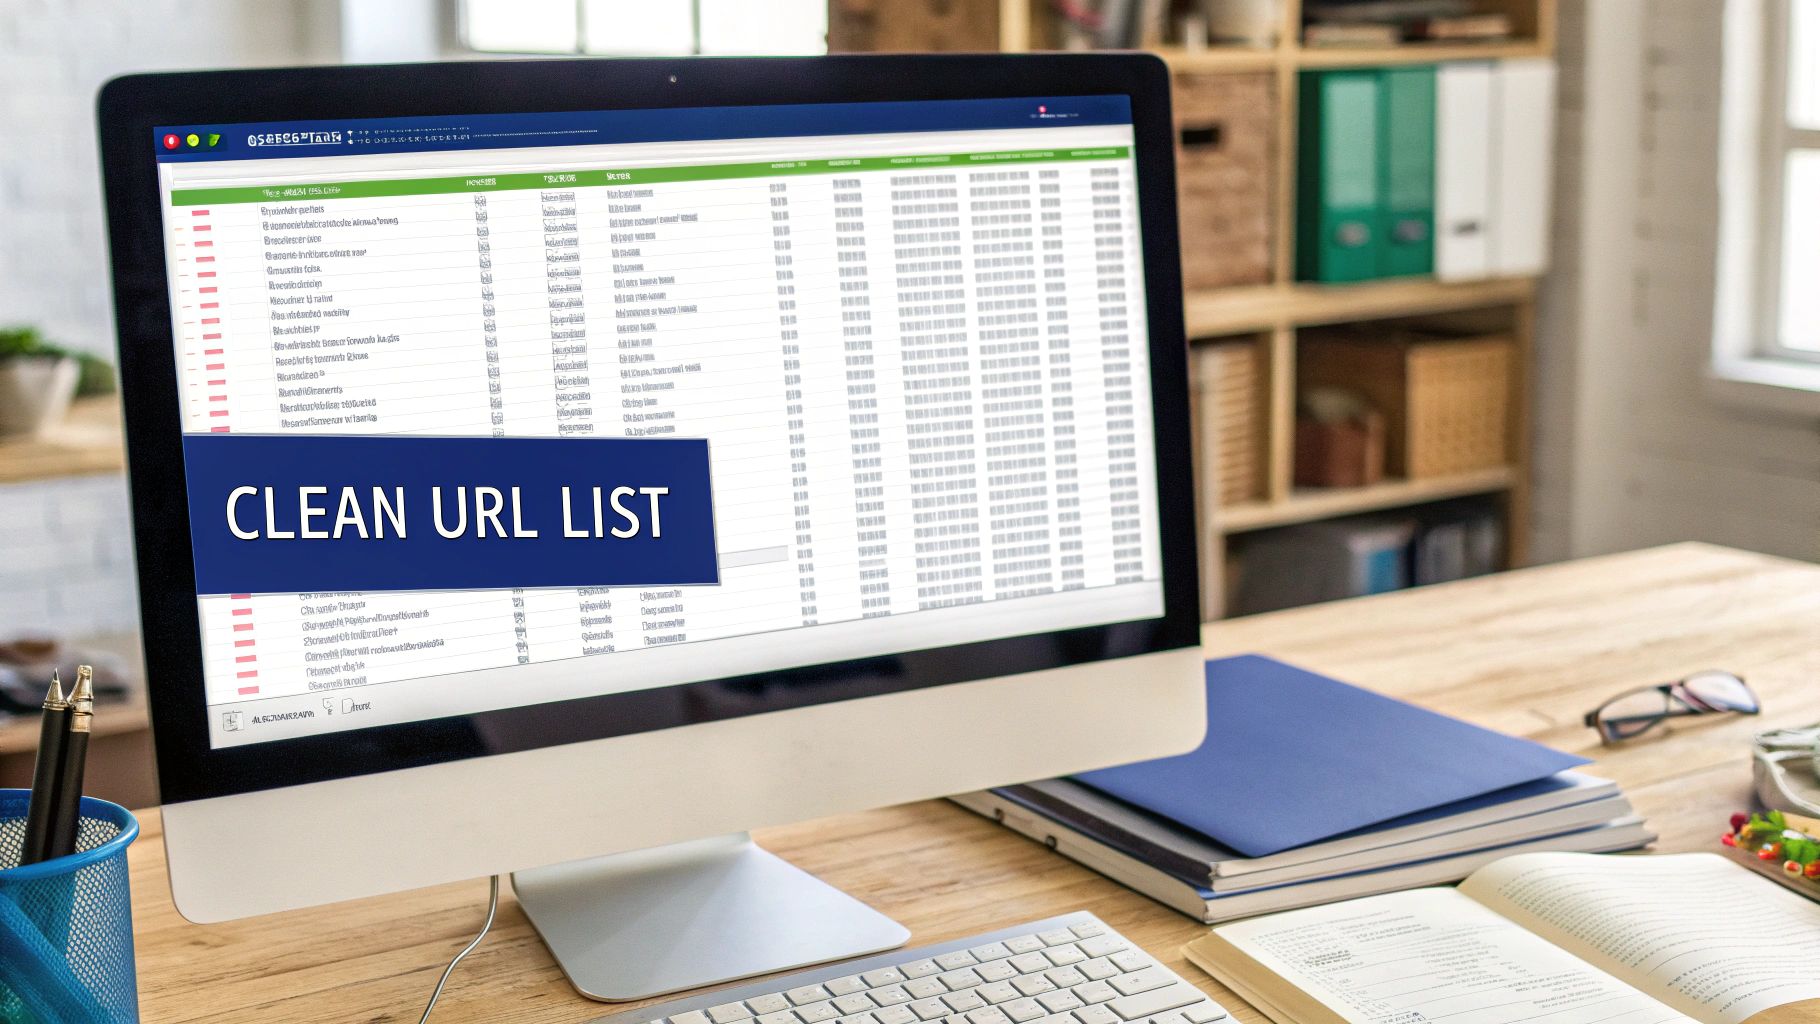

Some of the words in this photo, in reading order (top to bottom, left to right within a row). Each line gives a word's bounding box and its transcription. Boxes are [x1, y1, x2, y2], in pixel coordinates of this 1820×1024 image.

[225, 485, 407, 541] CLEAN
[432, 485, 538, 540] URL
[561, 485, 670, 540] LIST
